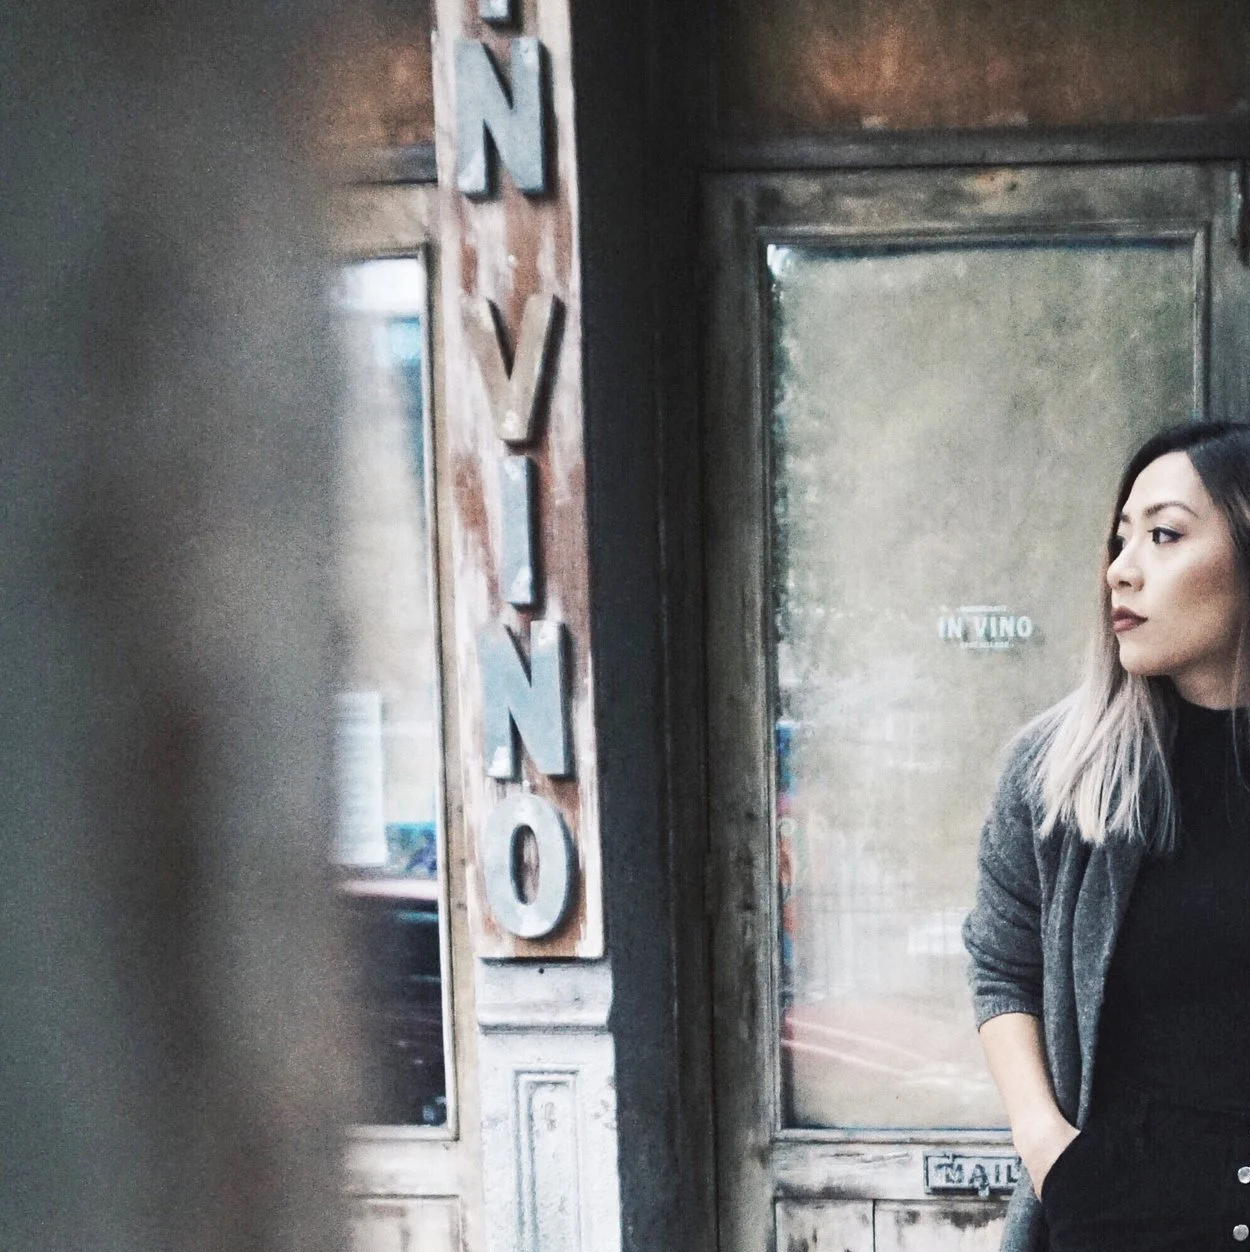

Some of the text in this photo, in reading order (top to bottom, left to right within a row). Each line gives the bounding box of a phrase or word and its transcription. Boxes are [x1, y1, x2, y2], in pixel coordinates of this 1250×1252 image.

[455, 0, 575, 940] N VINO
[938, 615, 1033, 638] IN VINO
[941, 1163, 1019, 1184] MAIL
